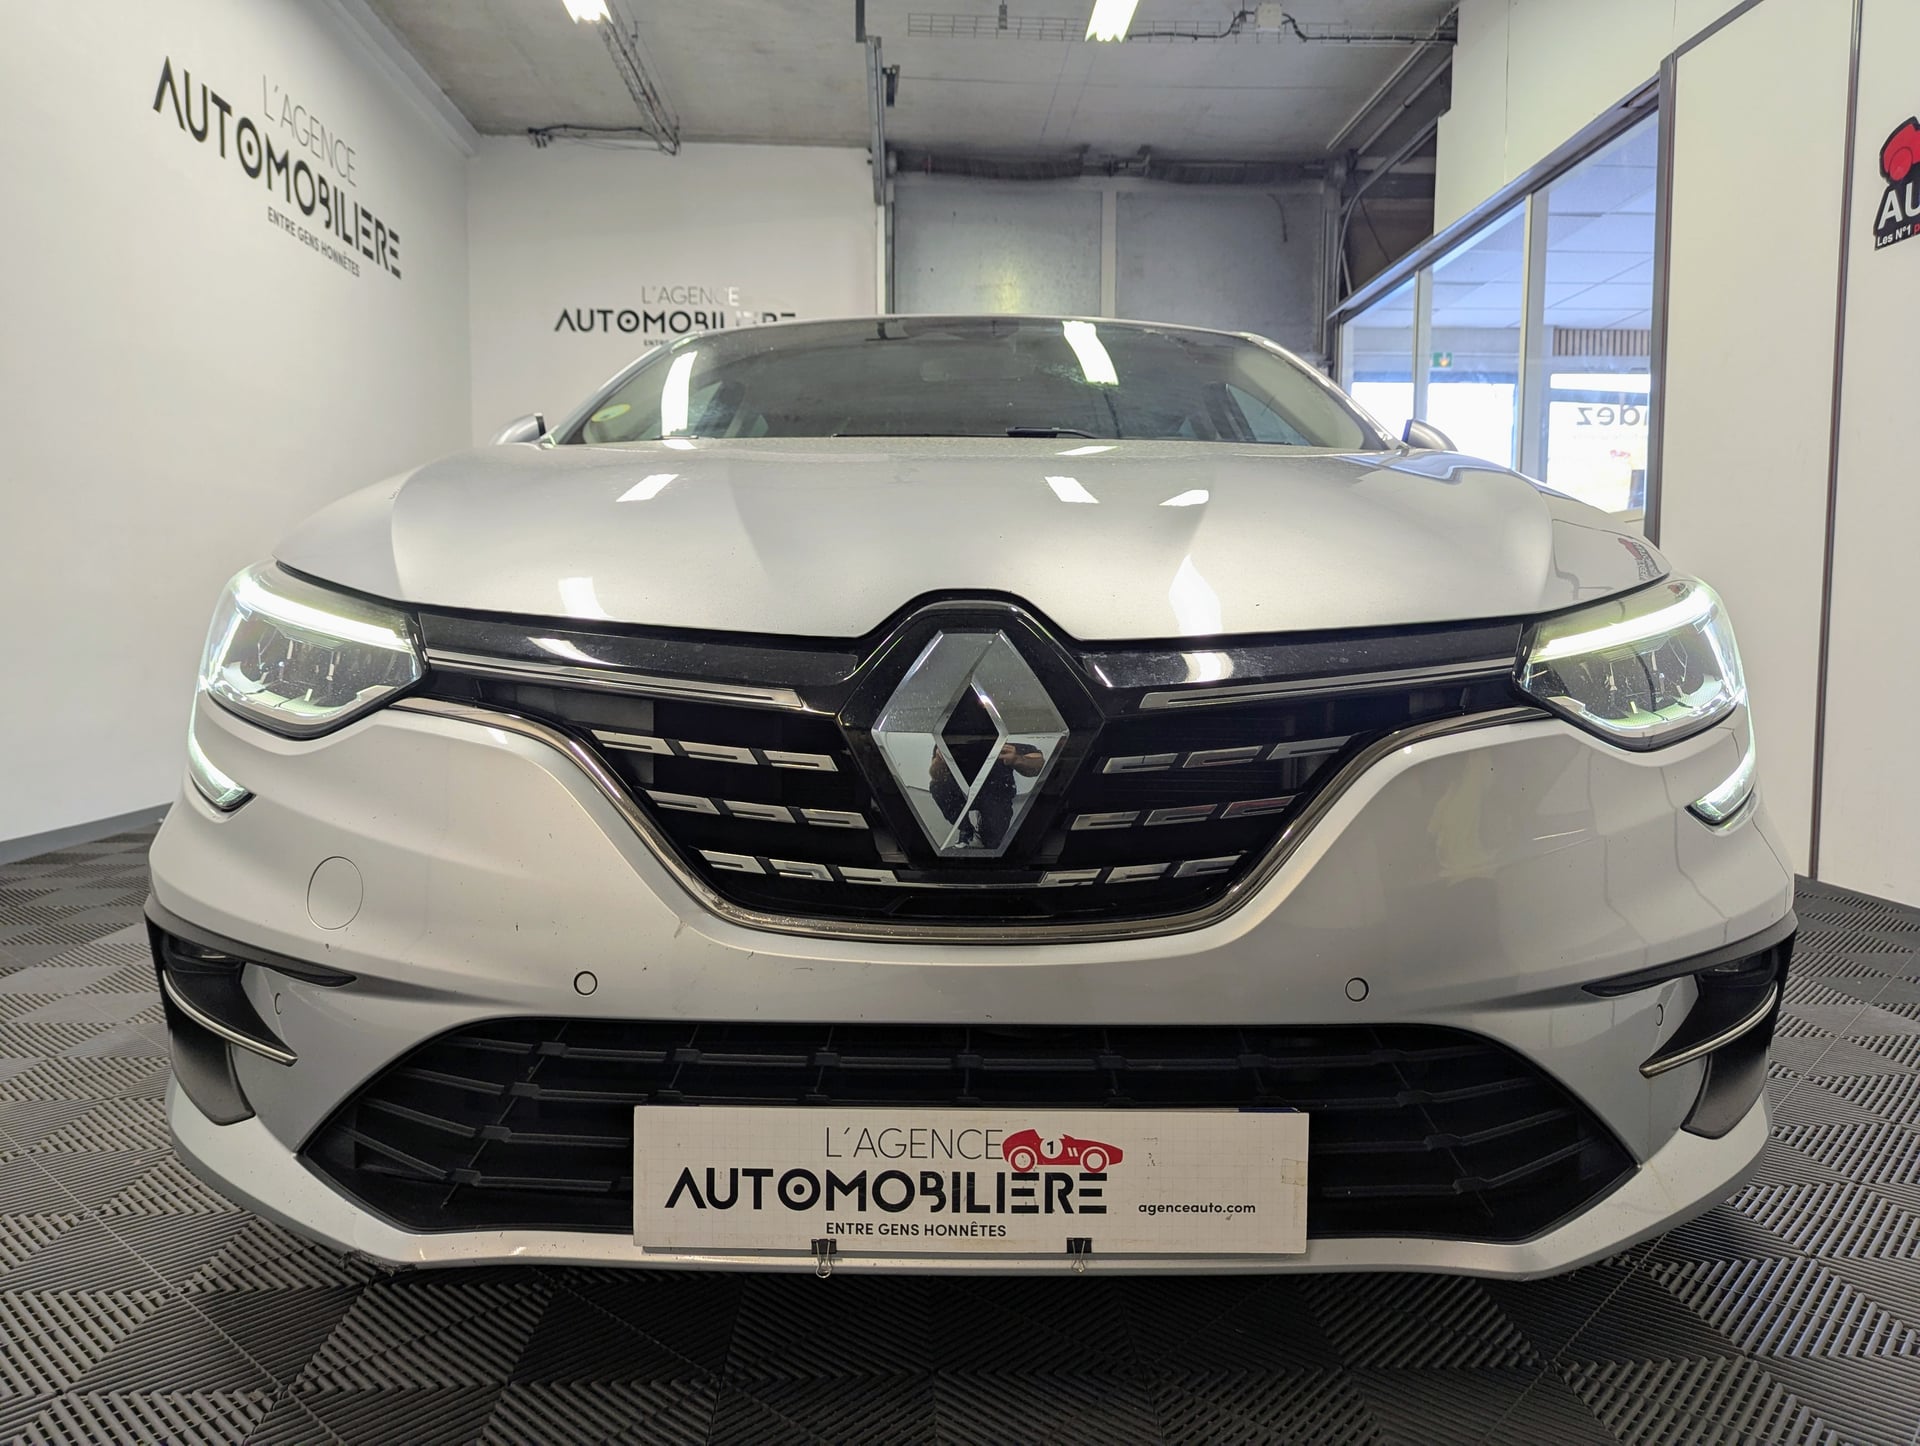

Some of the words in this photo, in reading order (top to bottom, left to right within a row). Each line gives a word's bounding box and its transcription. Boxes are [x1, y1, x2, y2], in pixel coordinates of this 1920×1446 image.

[263, 74, 357, 187] L'AGENCE
[152, 55, 401, 280] AUTOMOBILIERE
[268, 206, 296, 237] ENTRE
[298, 226, 320, 252] GENS
[1877, 233, 1893, 247] Les
[826, 1127, 1003, 1160] L'AGENCE
[1046, 1140, 1055, 1155] 1
[664, 1166, 1108, 1214] AUTOMOBILIERE
[1138, 1202, 1256, 1215] agenceauto.com
[826, 1222, 874, 1235] ENTRE
[878, 1222, 920, 1236] GENS
[924, 1221, 1007, 1237] HONNÊTES
